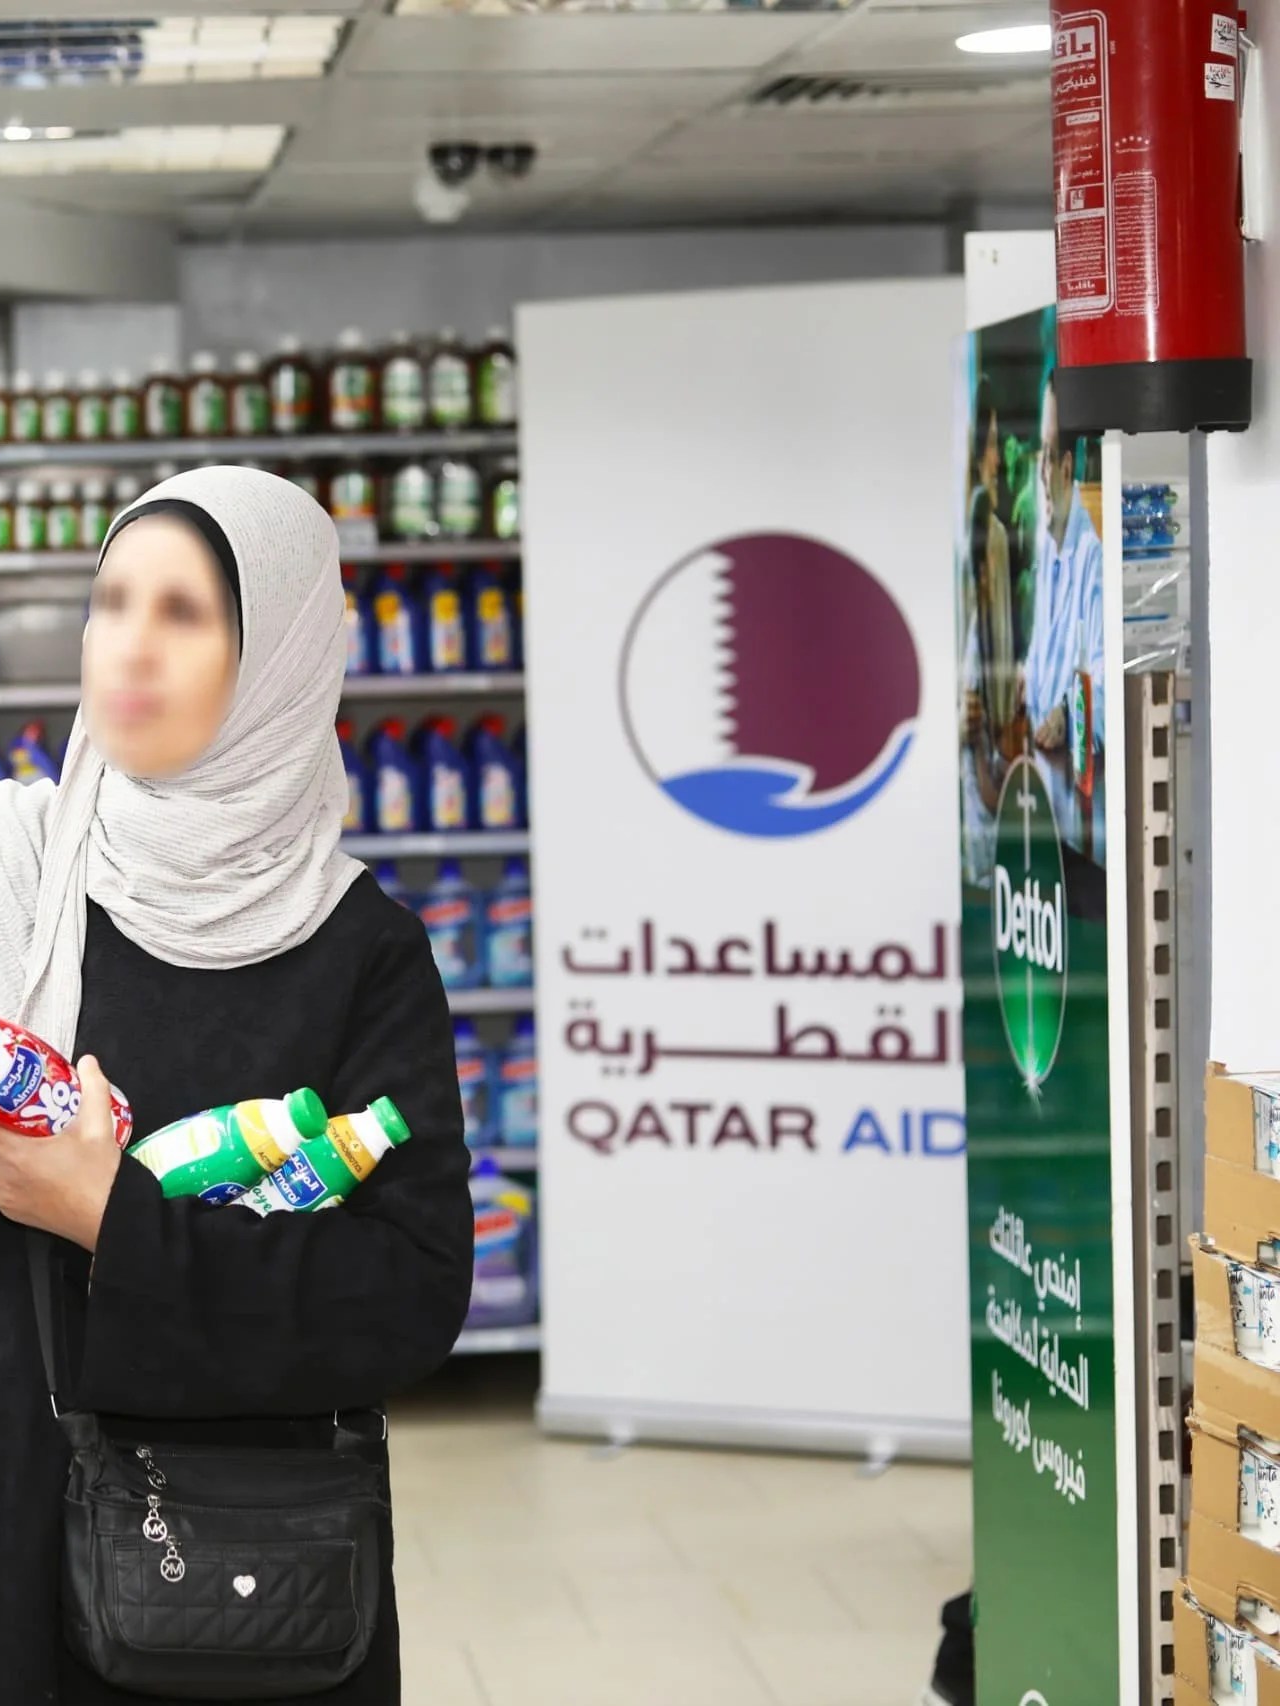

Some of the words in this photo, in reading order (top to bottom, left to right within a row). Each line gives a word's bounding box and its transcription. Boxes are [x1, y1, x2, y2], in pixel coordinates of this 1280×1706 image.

[994, 864, 1063, 973] Dettol
[564, 999, 964, 1076] لقطرية
[12, 1063, 41, 1107] Almarai
[566, 1100, 819, 1156] QATAR
[841, 1107, 967, 1156] AID
[252, 1186, 274, 1213] aye
[272, 1168, 300, 1205] lmarai
[291, 1153, 320, 1191] المراع
[986, 1283, 1039, 1368] لمكافحة
[1039, 1326, 1089, 1411] الحماية
[991, 1368, 1031, 1454] كورونا
[1032, 1436, 1086, 1505] فيروس
[147, 1523, 165, 1535] MK
